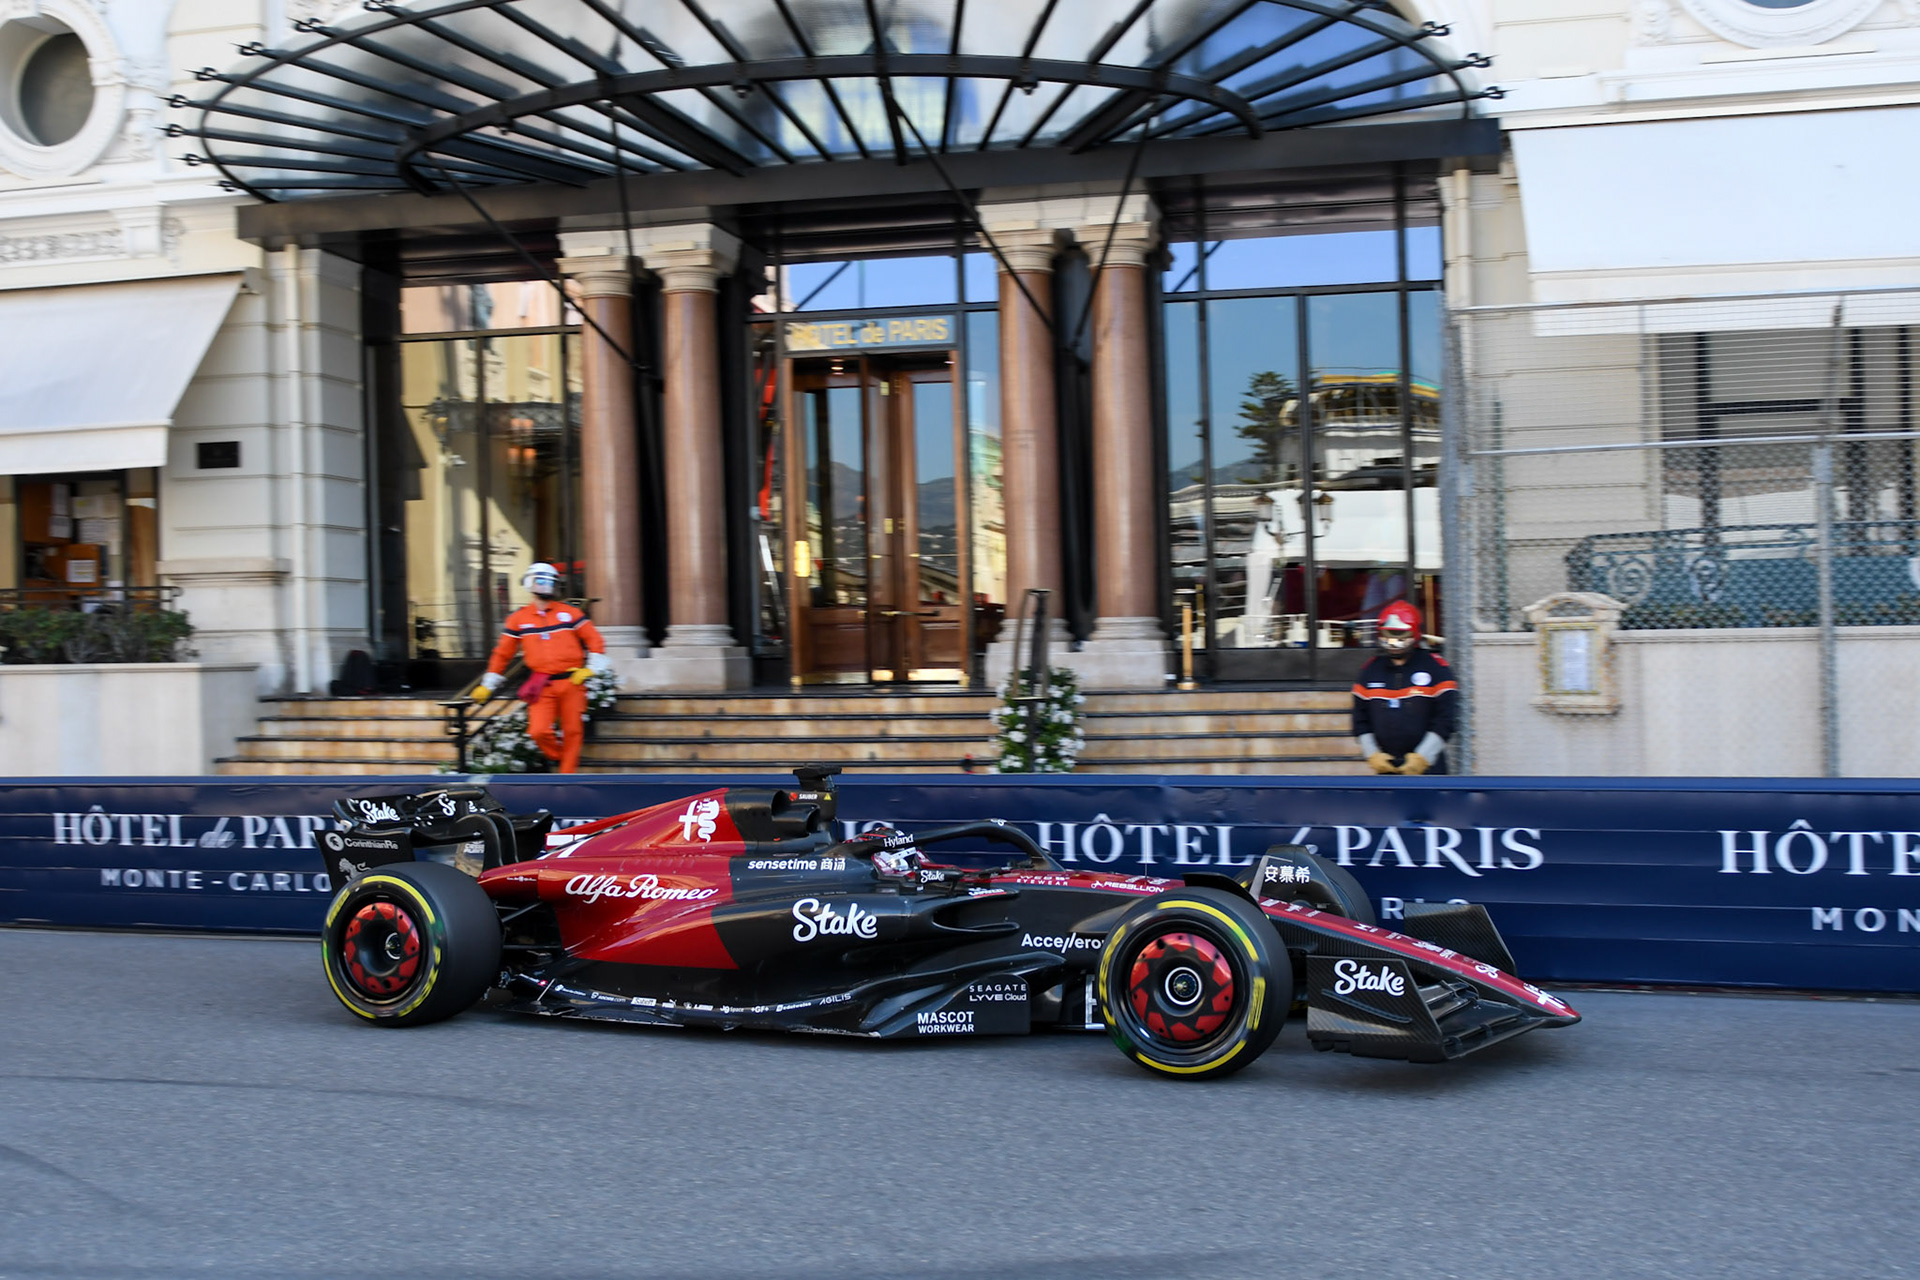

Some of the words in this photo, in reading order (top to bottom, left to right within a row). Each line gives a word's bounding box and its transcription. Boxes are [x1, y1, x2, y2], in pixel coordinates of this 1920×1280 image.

[889, 318, 949, 341] PARIS
[359, 800, 400, 824] Stake
[52, 804, 197, 847] HÔTEL
[200, 817, 236, 849] de
[242, 814, 343, 849] PAR
[344, 837, 399, 850] CorinthianRe
[884, 834, 914, 848] Hyland
[1036, 813, 1255, 866] HÔTEL
[1333, 826, 1545, 877] PARIS
[747, 859, 818, 870] sensetime
[820, 857, 846, 872] 商汤
[1264, 864, 1311, 884] 安慕希
[920, 869, 945, 884] Stake
[565, 874, 626, 904] Alfa
[625, 873, 719, 900] Romeo
[792, 897, 878, 942] Stake
[969, 983, 1027, 993] SEAGATE
[1334, 960, 1405, 997] Stake
[969, 993, 1003, 1002] LYVE
[1004, 992, 1027, 1002] Cloud
[917, 1011, 974, 1025] MASCOT
[918, 1023, 975, 1034] WORKWEAR
